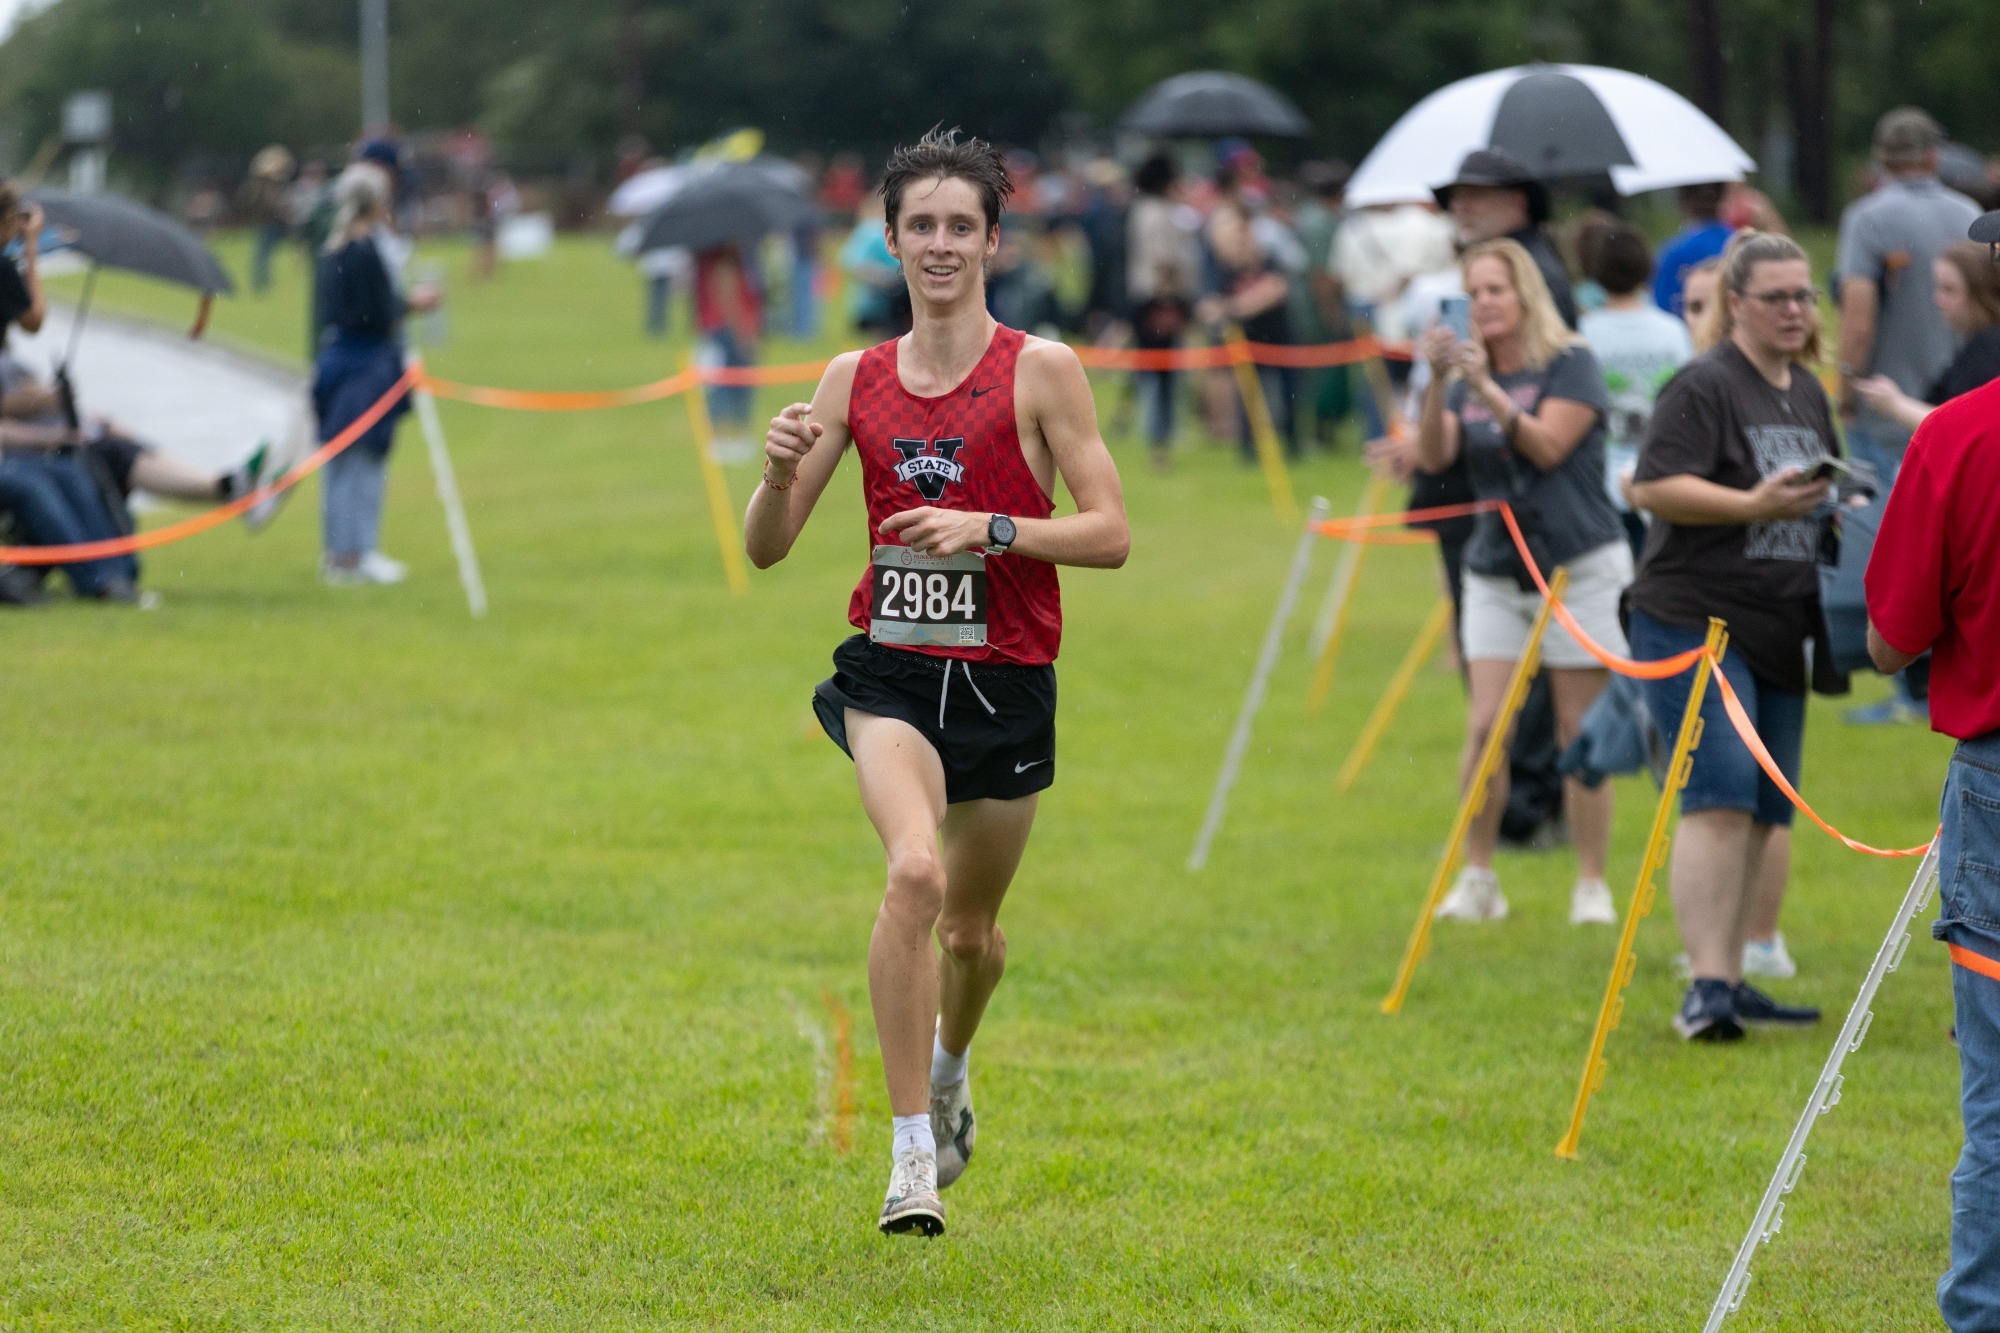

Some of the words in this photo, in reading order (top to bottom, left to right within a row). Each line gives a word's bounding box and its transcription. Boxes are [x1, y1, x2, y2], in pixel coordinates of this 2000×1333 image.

[892, 437, 964, 501] V
[907, 459, 952, 475] STATE
[880, 569, 976, 620] 2984
